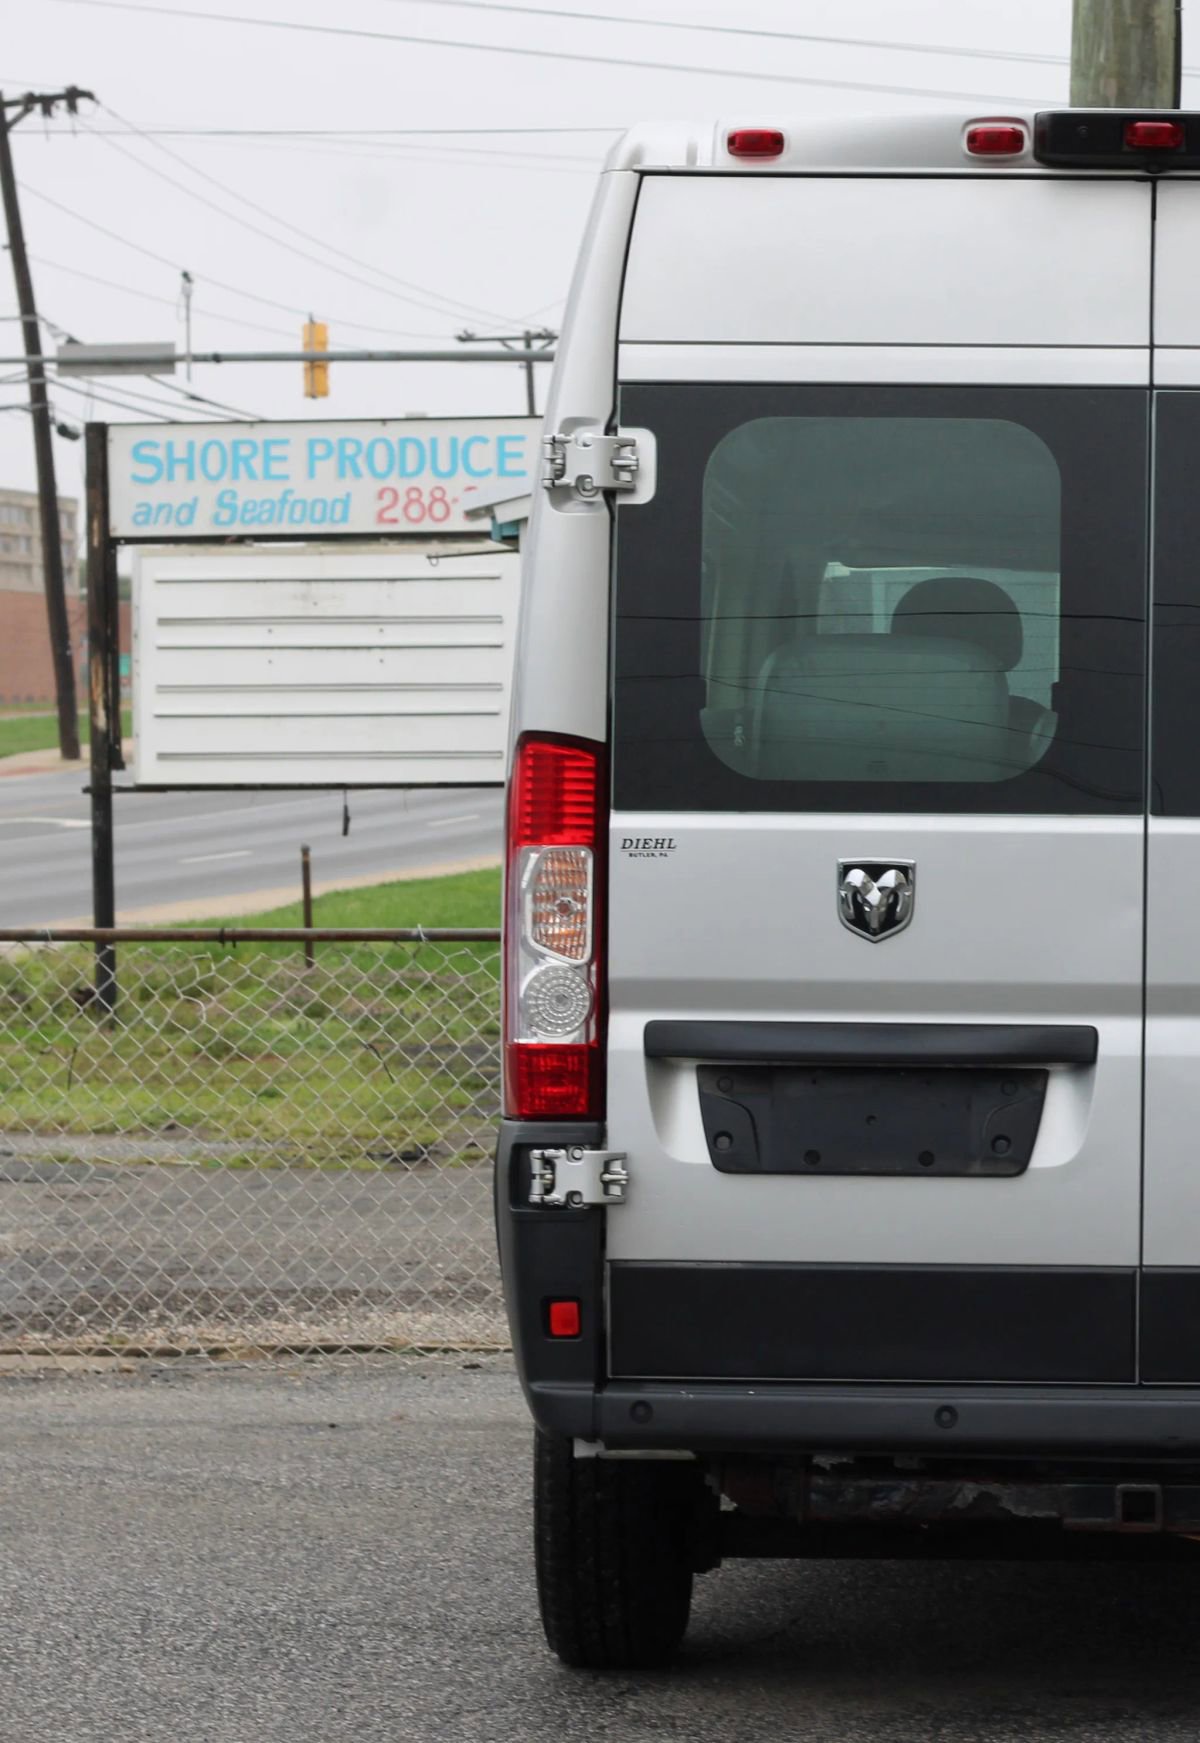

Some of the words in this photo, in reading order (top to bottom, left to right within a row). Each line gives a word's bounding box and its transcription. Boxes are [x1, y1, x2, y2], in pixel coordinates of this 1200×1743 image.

[130, 438, 291, 484] SHORE
[307, 434, 528, 481] PRODUCE
[131, 498, 197, 527] and
[212, 490, 352, 527] Seafood
[375, 486, 478, 524] 288-
[621, 838, 677, 849] DIEHL
